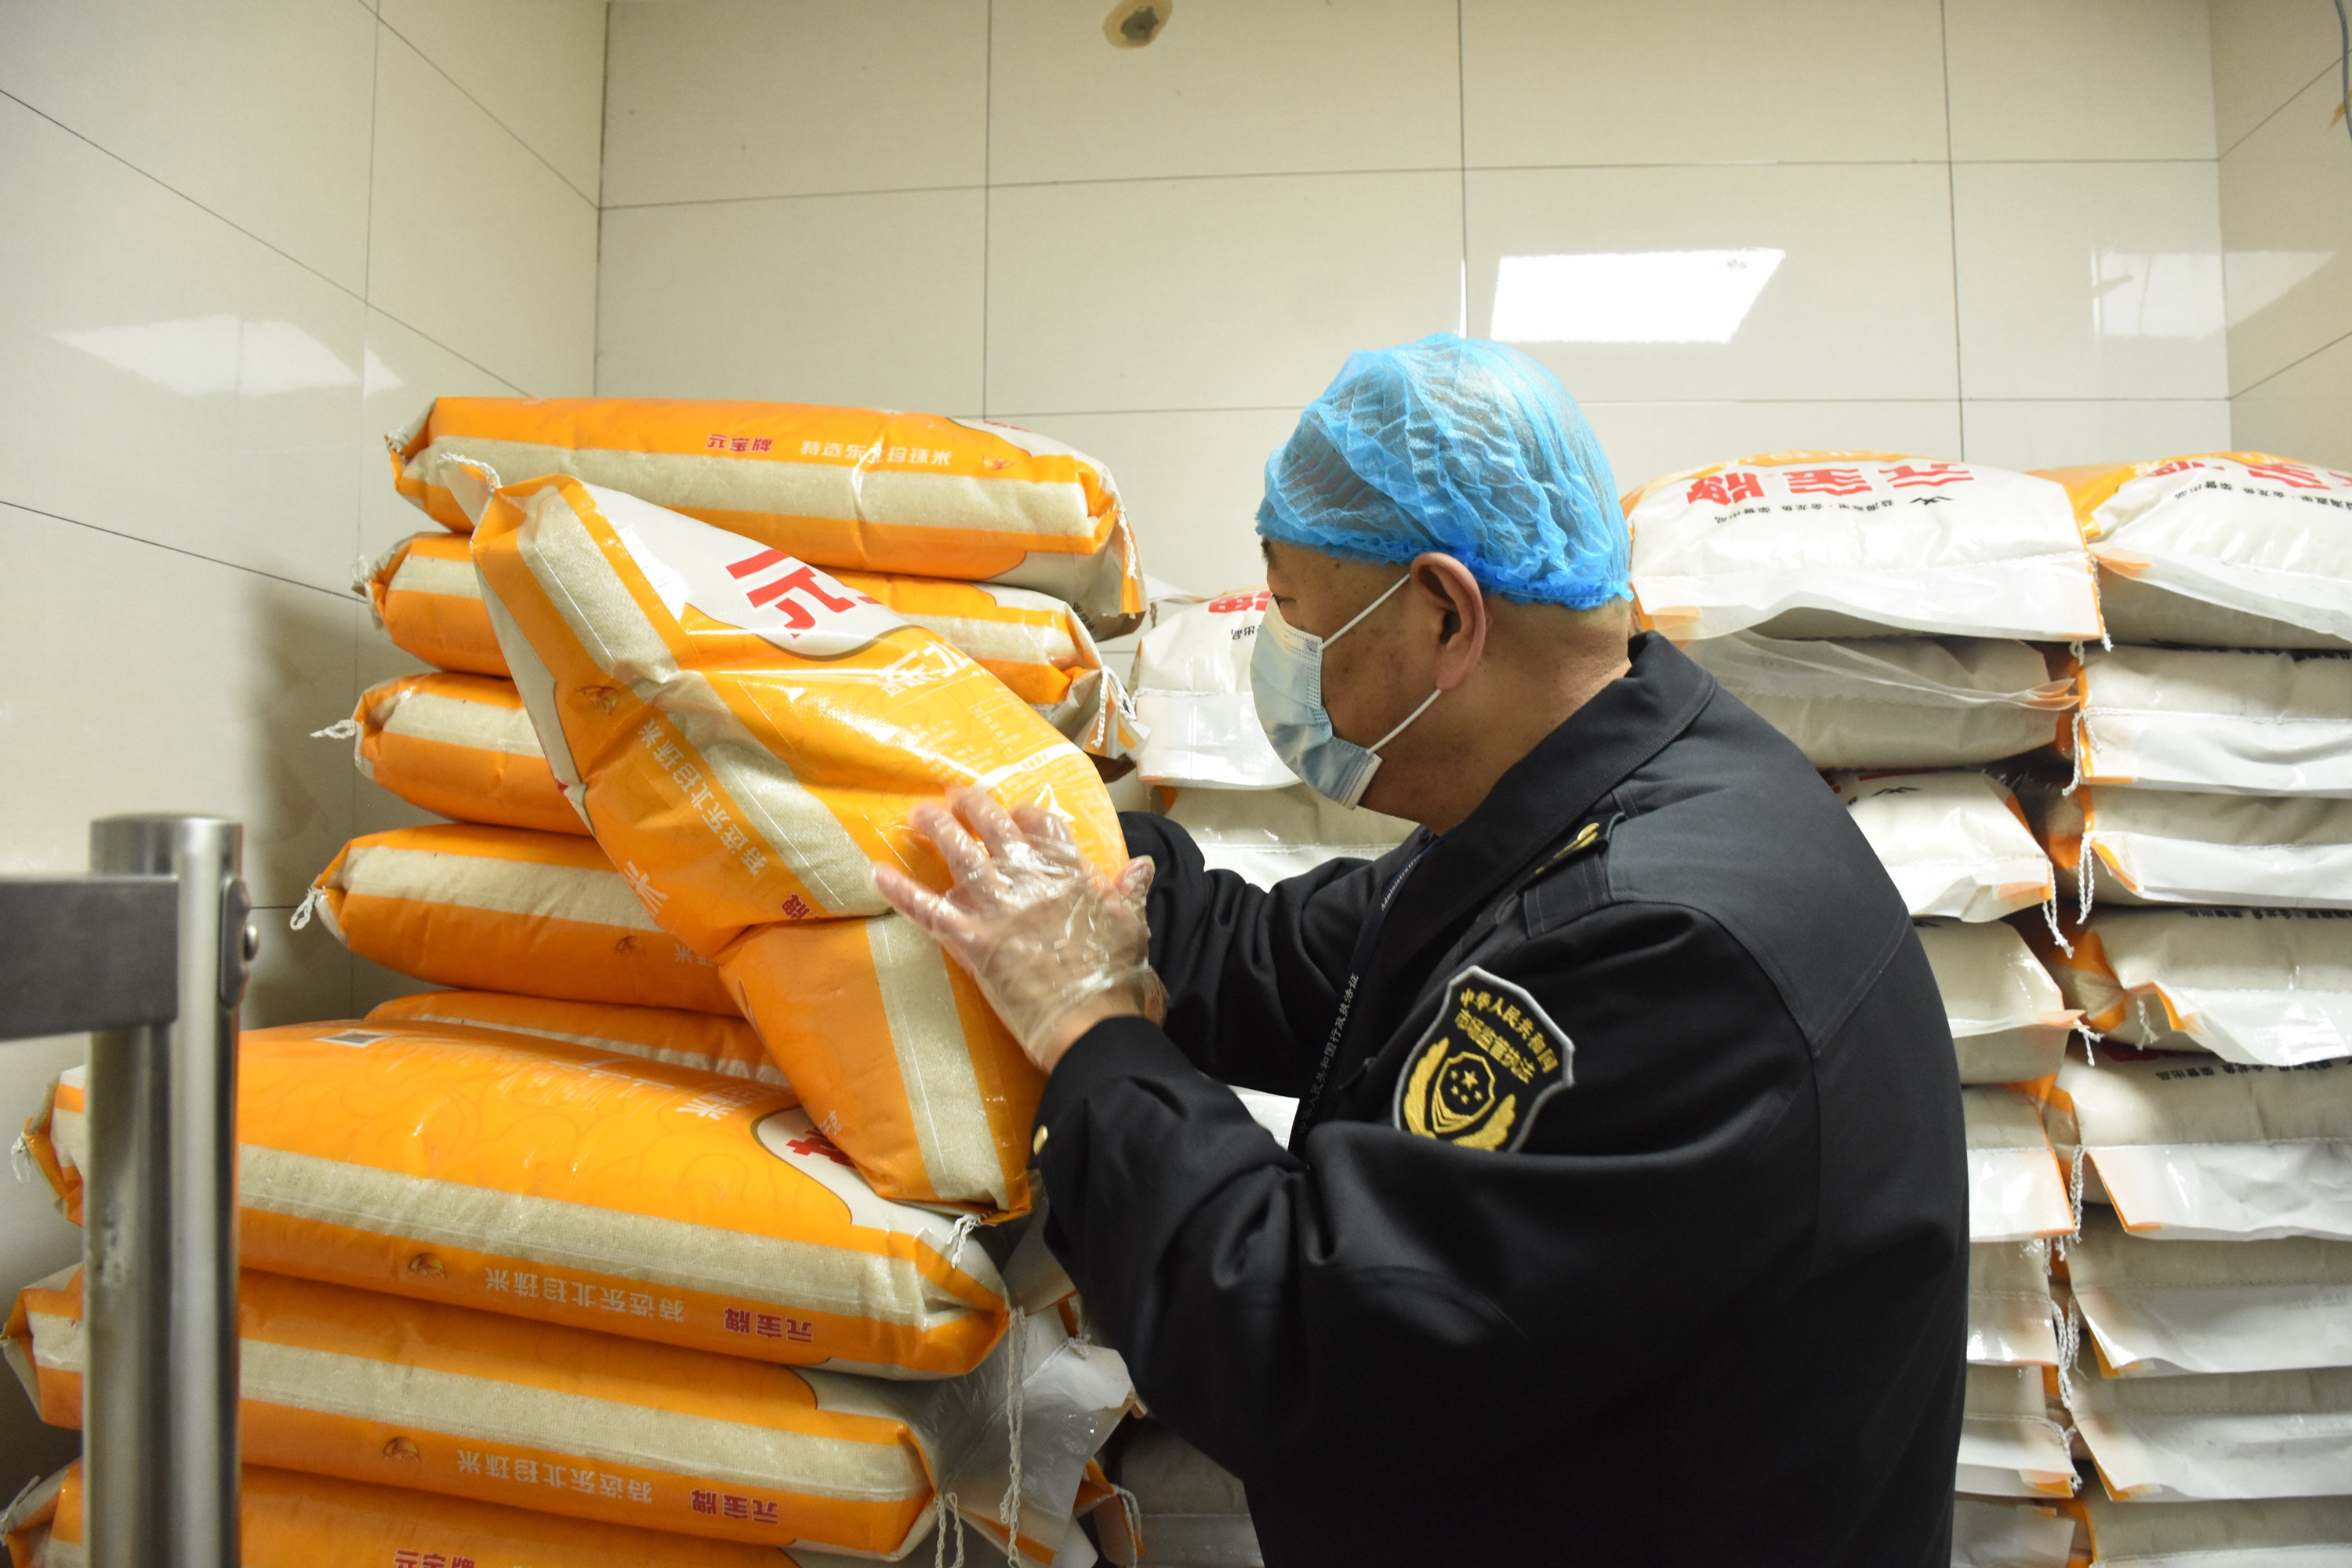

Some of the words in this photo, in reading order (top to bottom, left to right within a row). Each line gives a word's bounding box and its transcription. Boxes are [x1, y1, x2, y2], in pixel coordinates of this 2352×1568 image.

[706, 433, 772, 452] 元宝牌
[725, 548, 881, 640] 元
[637, 709, 768, 876] 特选东北珍珠米
[1298, 972, 1359, 1134] 中华人民共和国行政执法证
[1454, 1007, 1536, 1084] 市场监管执法
[1460, 986, 1559, 1075] 中华人民共和国
[485, 1266, 684, 1323] 特选东北珍珠米
[724, 1306, 813, 1343] 元宝牌
[456, 1449, 653, 1504] 特选东北珍珠米
[691, 1487, 779, 1525] 元宝牌
